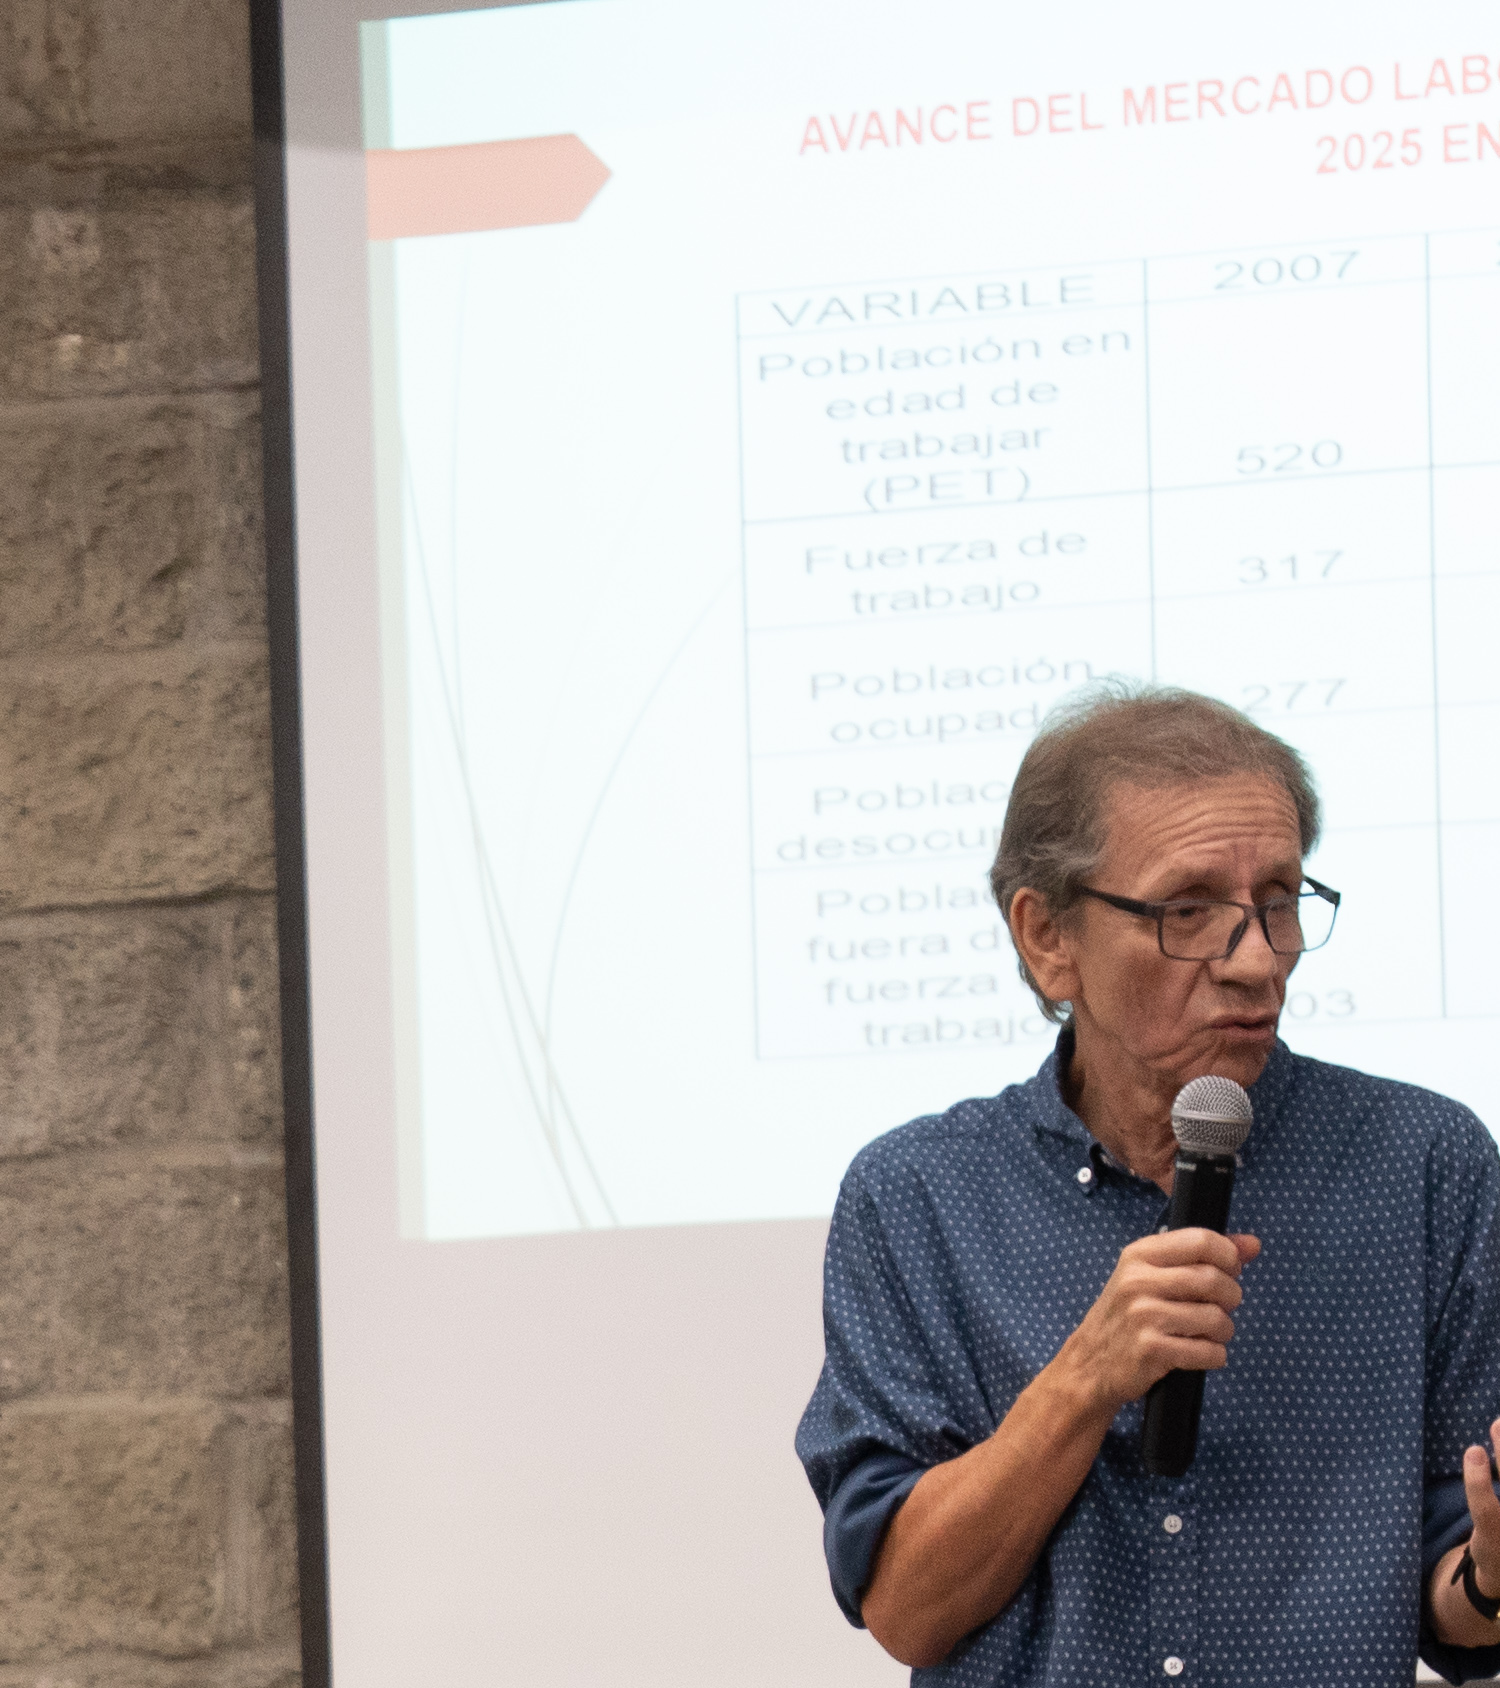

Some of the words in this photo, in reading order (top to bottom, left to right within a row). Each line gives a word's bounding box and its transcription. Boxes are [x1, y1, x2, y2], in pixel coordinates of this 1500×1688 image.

[800, 99, 993, 156] AVANCE
[1011, 90, 1105, 137] DEL
[1122, 64, 1375, 127] MERCADO
[1316, 127, 1424, 175] 2025
[1212, 249, 1361, 293] 2007
[772, 272, 1095, 330] VARIABLE
[757, 330, 1043, 383] Población
[1060, 327, 1133, 359] en
[825, 383, 968, 422] edad
[989, 378, 1061, 409] de
[839, 424, 1052, 466] trabajar
[1235, 439, 1344, 477] 520
[861, 467, 1032, 513] (PET)
[804, 537, 998, 576] Fuerza
[1017, 529, 1089, 558] de
[1236, 549, 1346, 585] 317
[850, 577, 1042, 616] trabajo
[1240, 676, 1348, 714] 277
[829, 701, 1041, 744] ocupad
[812, 778, 1009, 817] Poblac
[776, 826, 1000, 863] desocu
[815, 882, 996, 919] Pobla
[806, 933, 951, 965] fuera
[822, 972, 1000, 1007] fuerza
[1284, 987, 1358, 1022] 03
[862, 1009, 1053, 1049] trabajo
